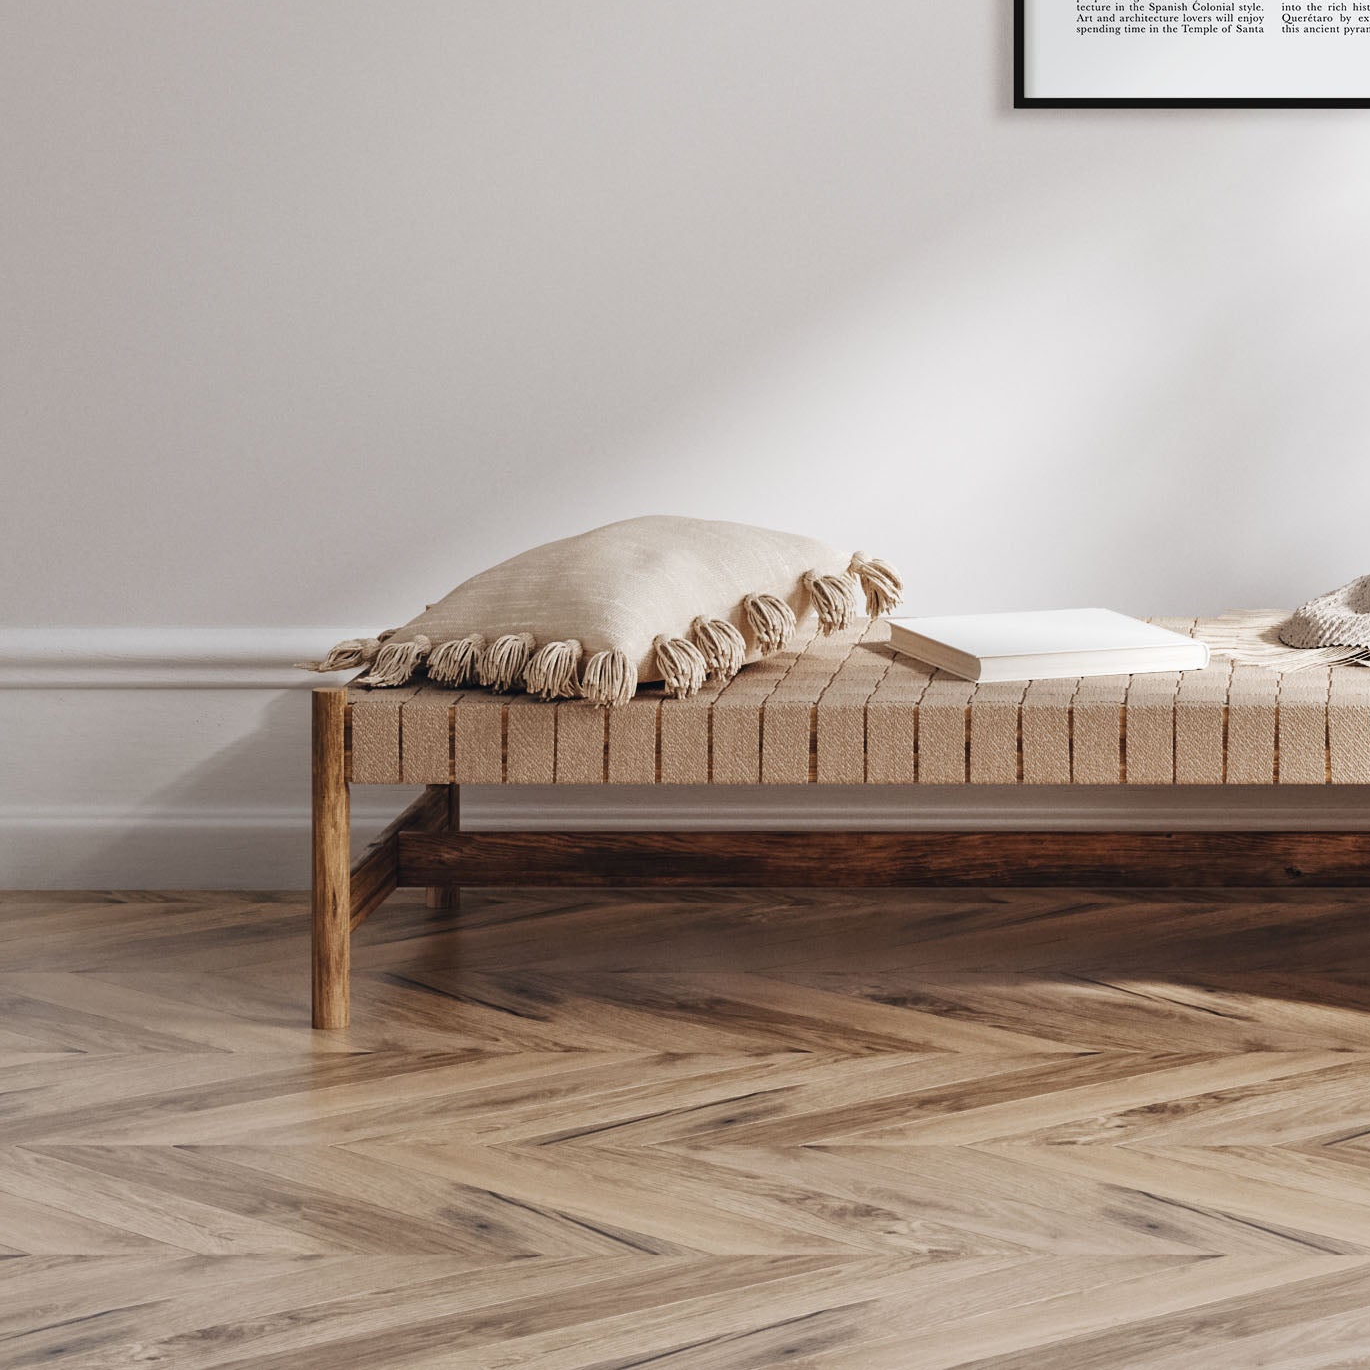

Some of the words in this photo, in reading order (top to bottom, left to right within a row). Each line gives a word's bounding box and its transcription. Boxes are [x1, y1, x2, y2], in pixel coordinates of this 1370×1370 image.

[1077, 3, 1111, 11] tecture
[1115, 3, 1125, 11] in
[1129, 3, 1144, 11] the
[1149, 3, 1187, 14] Spanish
[1192, 3, 1234, 11] Colonial
[1239, 3, 1264, 14] style.
[1282, 3, 1301, 11] into
[1307, 3, 1322, 11] the
[1328, 3, 1347, 11] rich
[1076, 24, 1121, 36] spending
[1124, 24, 1146, 33] time
[1149, 24, 1159, 33] in
[1163, 24, 1178, 33] the
[1181, 24, 1218, 36] Temple
[1221, 24, 1233, 33] of
[1236, 24, 1264, 33] Santa
[1282, 24, 1299, 33] this
[1303, 24, 1340, 33] ancient
